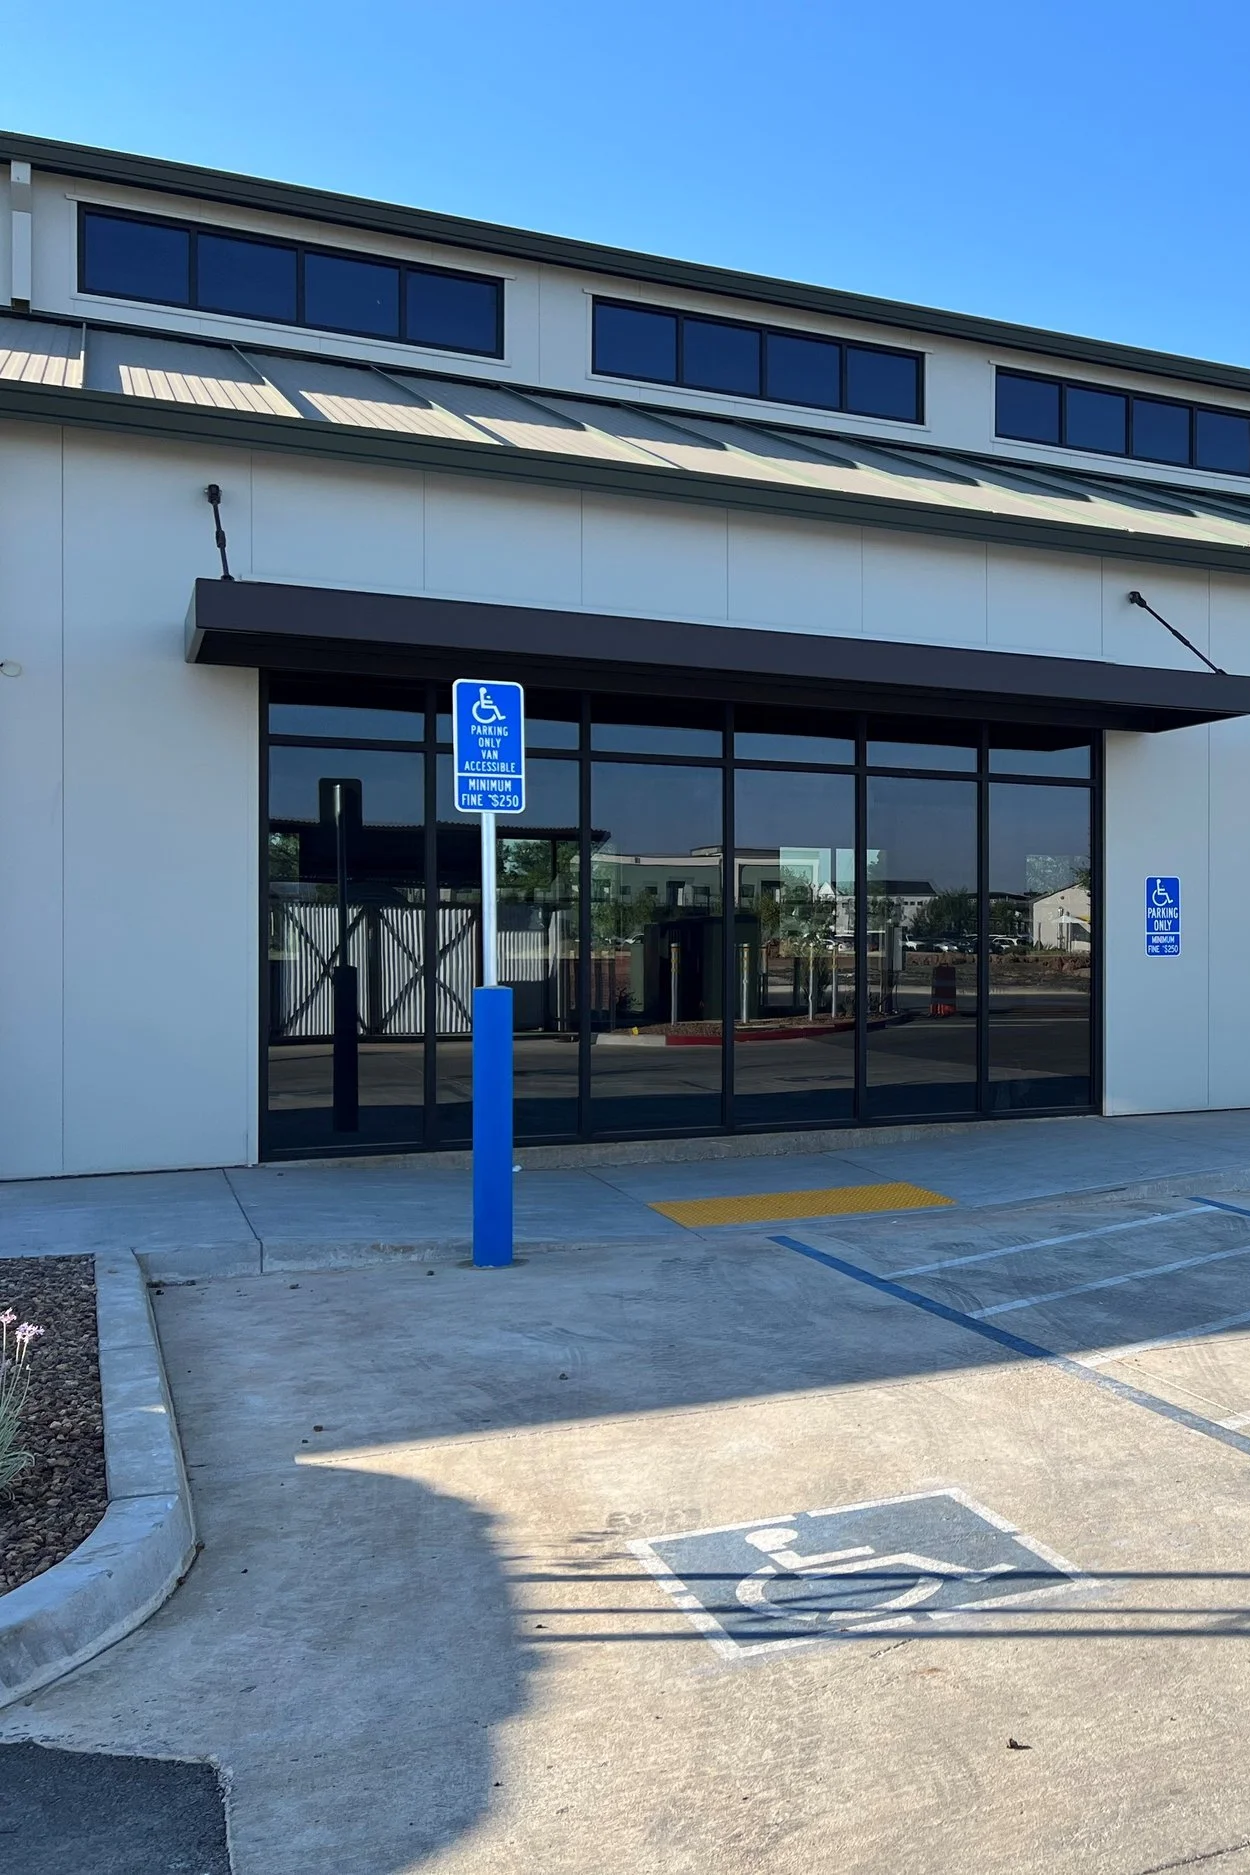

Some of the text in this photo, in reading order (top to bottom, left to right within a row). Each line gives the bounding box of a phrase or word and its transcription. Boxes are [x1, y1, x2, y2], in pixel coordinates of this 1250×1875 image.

[471, 725, 508, 737] PARKING
[478, 737, 501, 748] ONLY
[481, 750, 498, 760] VAN
[464, 761, 516, 772] ACCESSIBLE
[468, 779, 512, 792] MINIMUM
[461, 794, 483, 806] FINE
[1148, 907, 1178, 918] PARKING
[1154, 920, 1172, 931] ONLY
